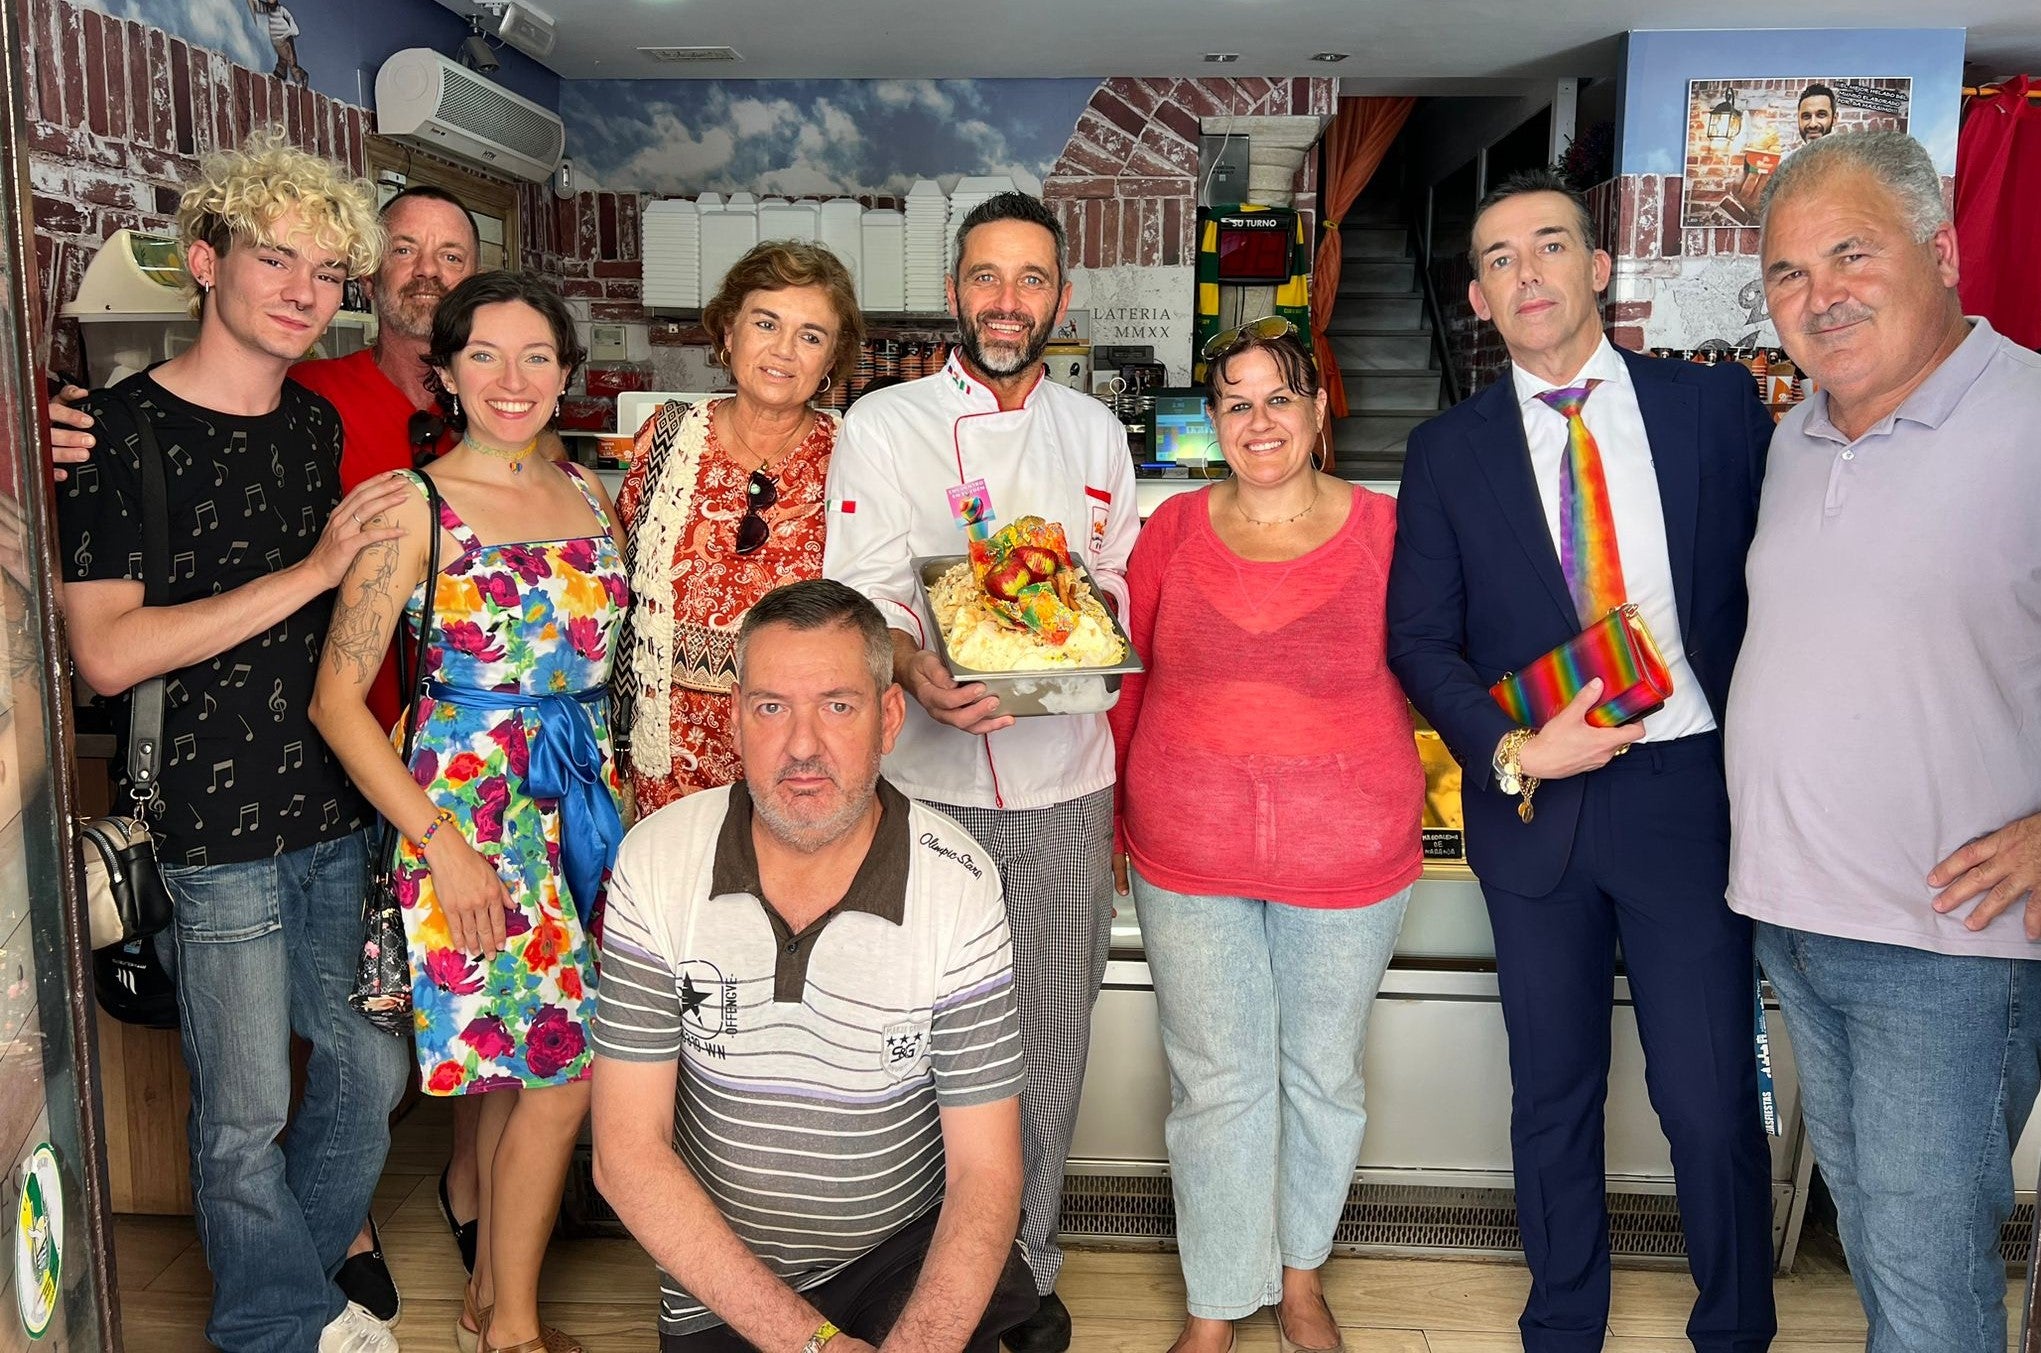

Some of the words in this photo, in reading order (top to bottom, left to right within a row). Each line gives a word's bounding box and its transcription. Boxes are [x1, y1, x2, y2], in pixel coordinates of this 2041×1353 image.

[1870, 89, 1895, 98] HELADO
[1862, 95, 1901, 106] ELABORADO
[1246, 219, 1277, 228] TURNO
[1114, 326, 1170, 338] MMXX
